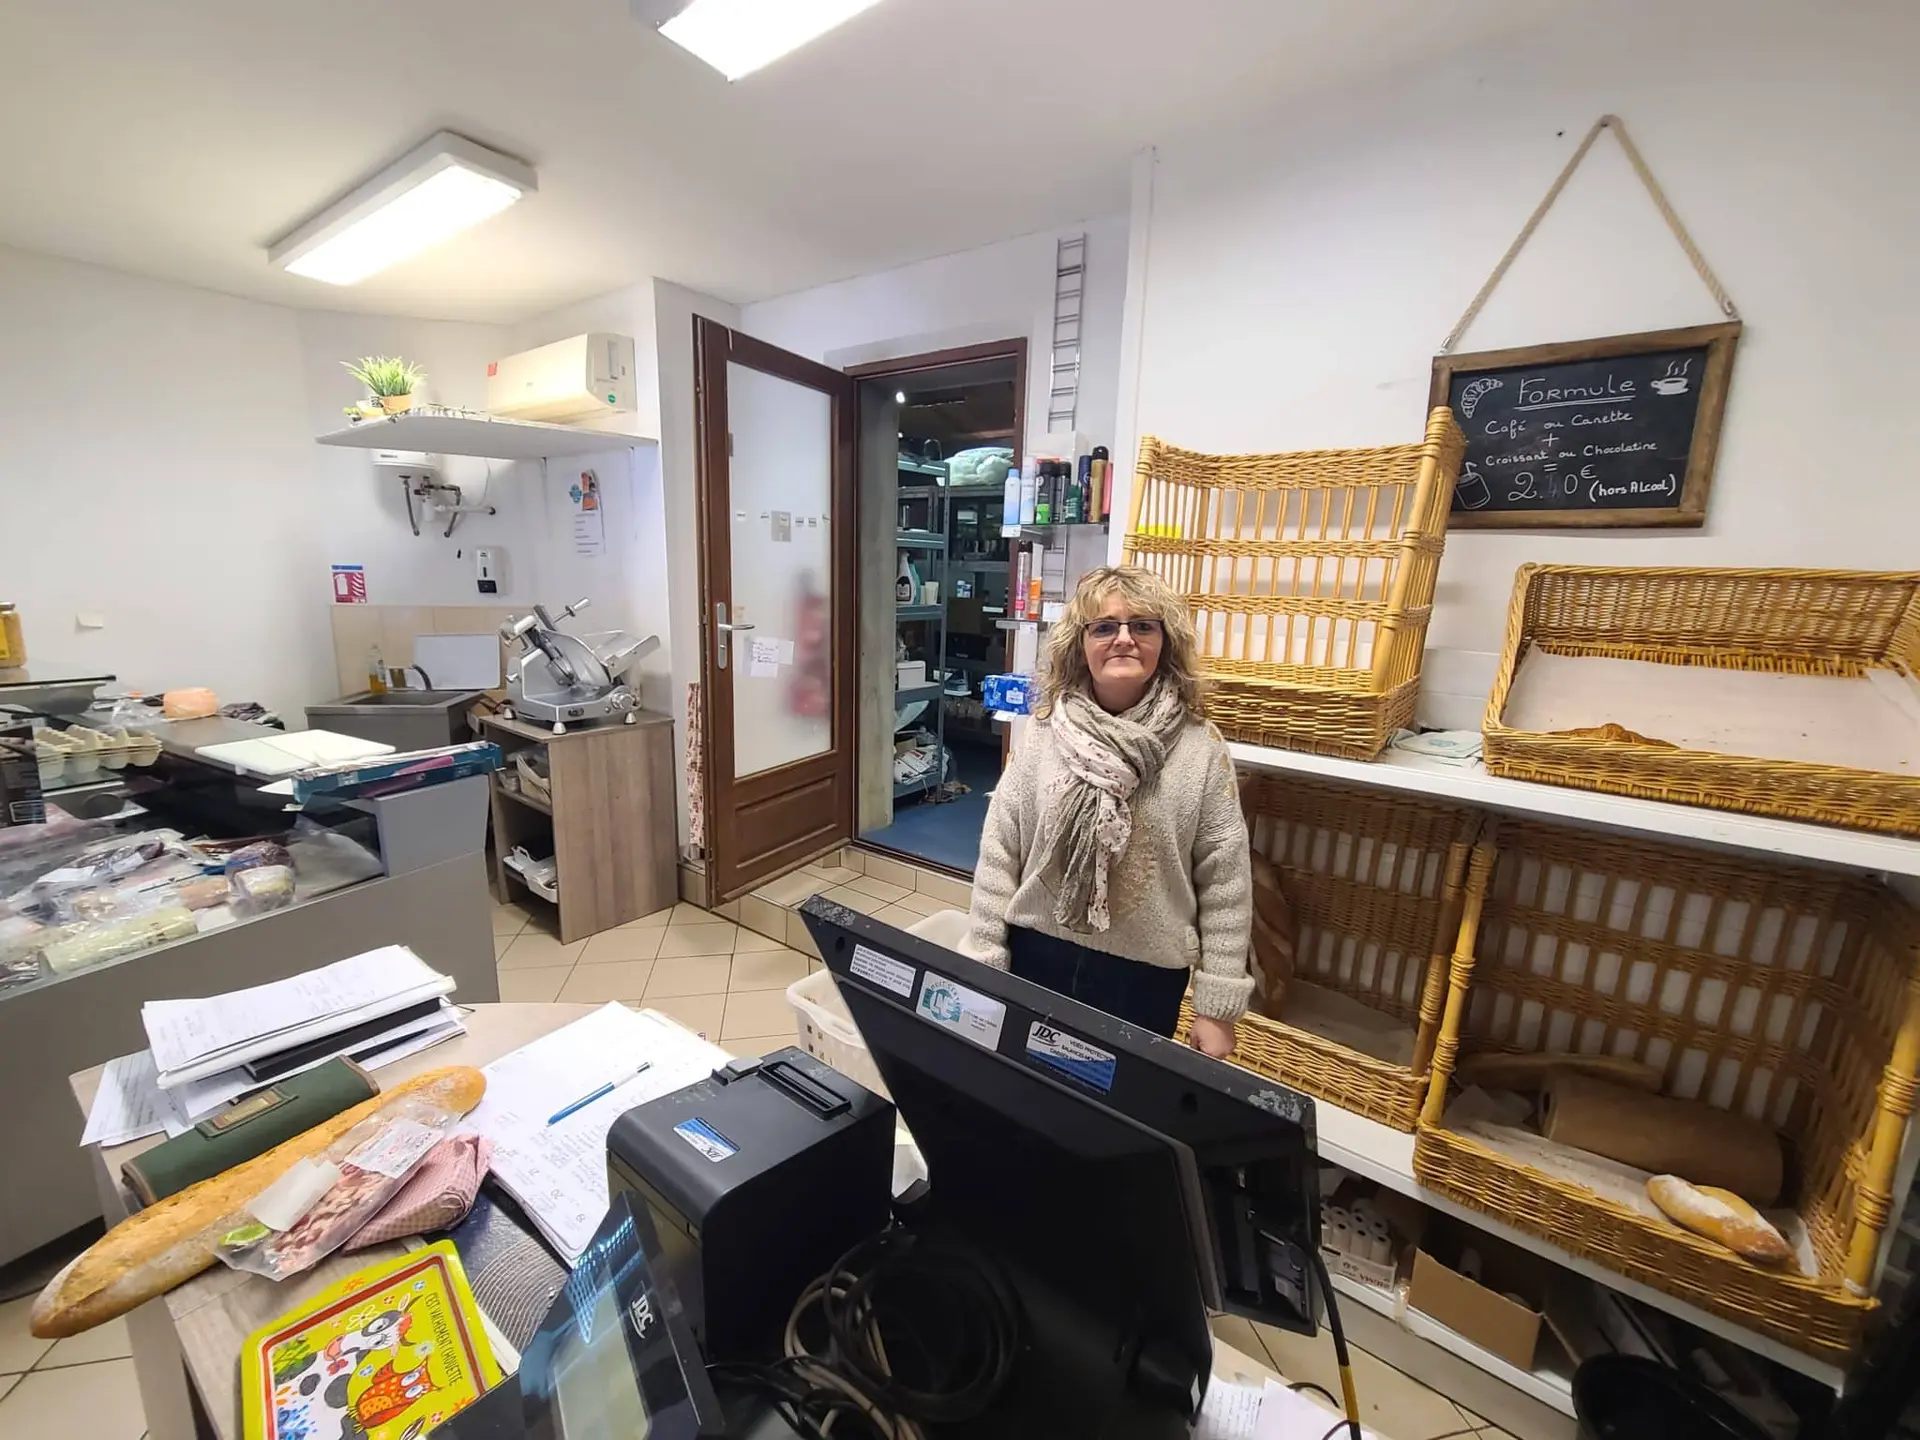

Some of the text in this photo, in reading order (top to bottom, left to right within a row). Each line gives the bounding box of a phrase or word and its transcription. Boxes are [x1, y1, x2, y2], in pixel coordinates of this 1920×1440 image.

[1485, 410, 1633, 439] Café ou Canette
[1486, 450, 1549, 466] Croissant
[1583, 443, 1658, 456] Chocolatine
[1589, 480, 1627, 502] (hors
[1032, 1025, 1061, 1043] JDC
[631, 1293, 653, 1331] JDC
